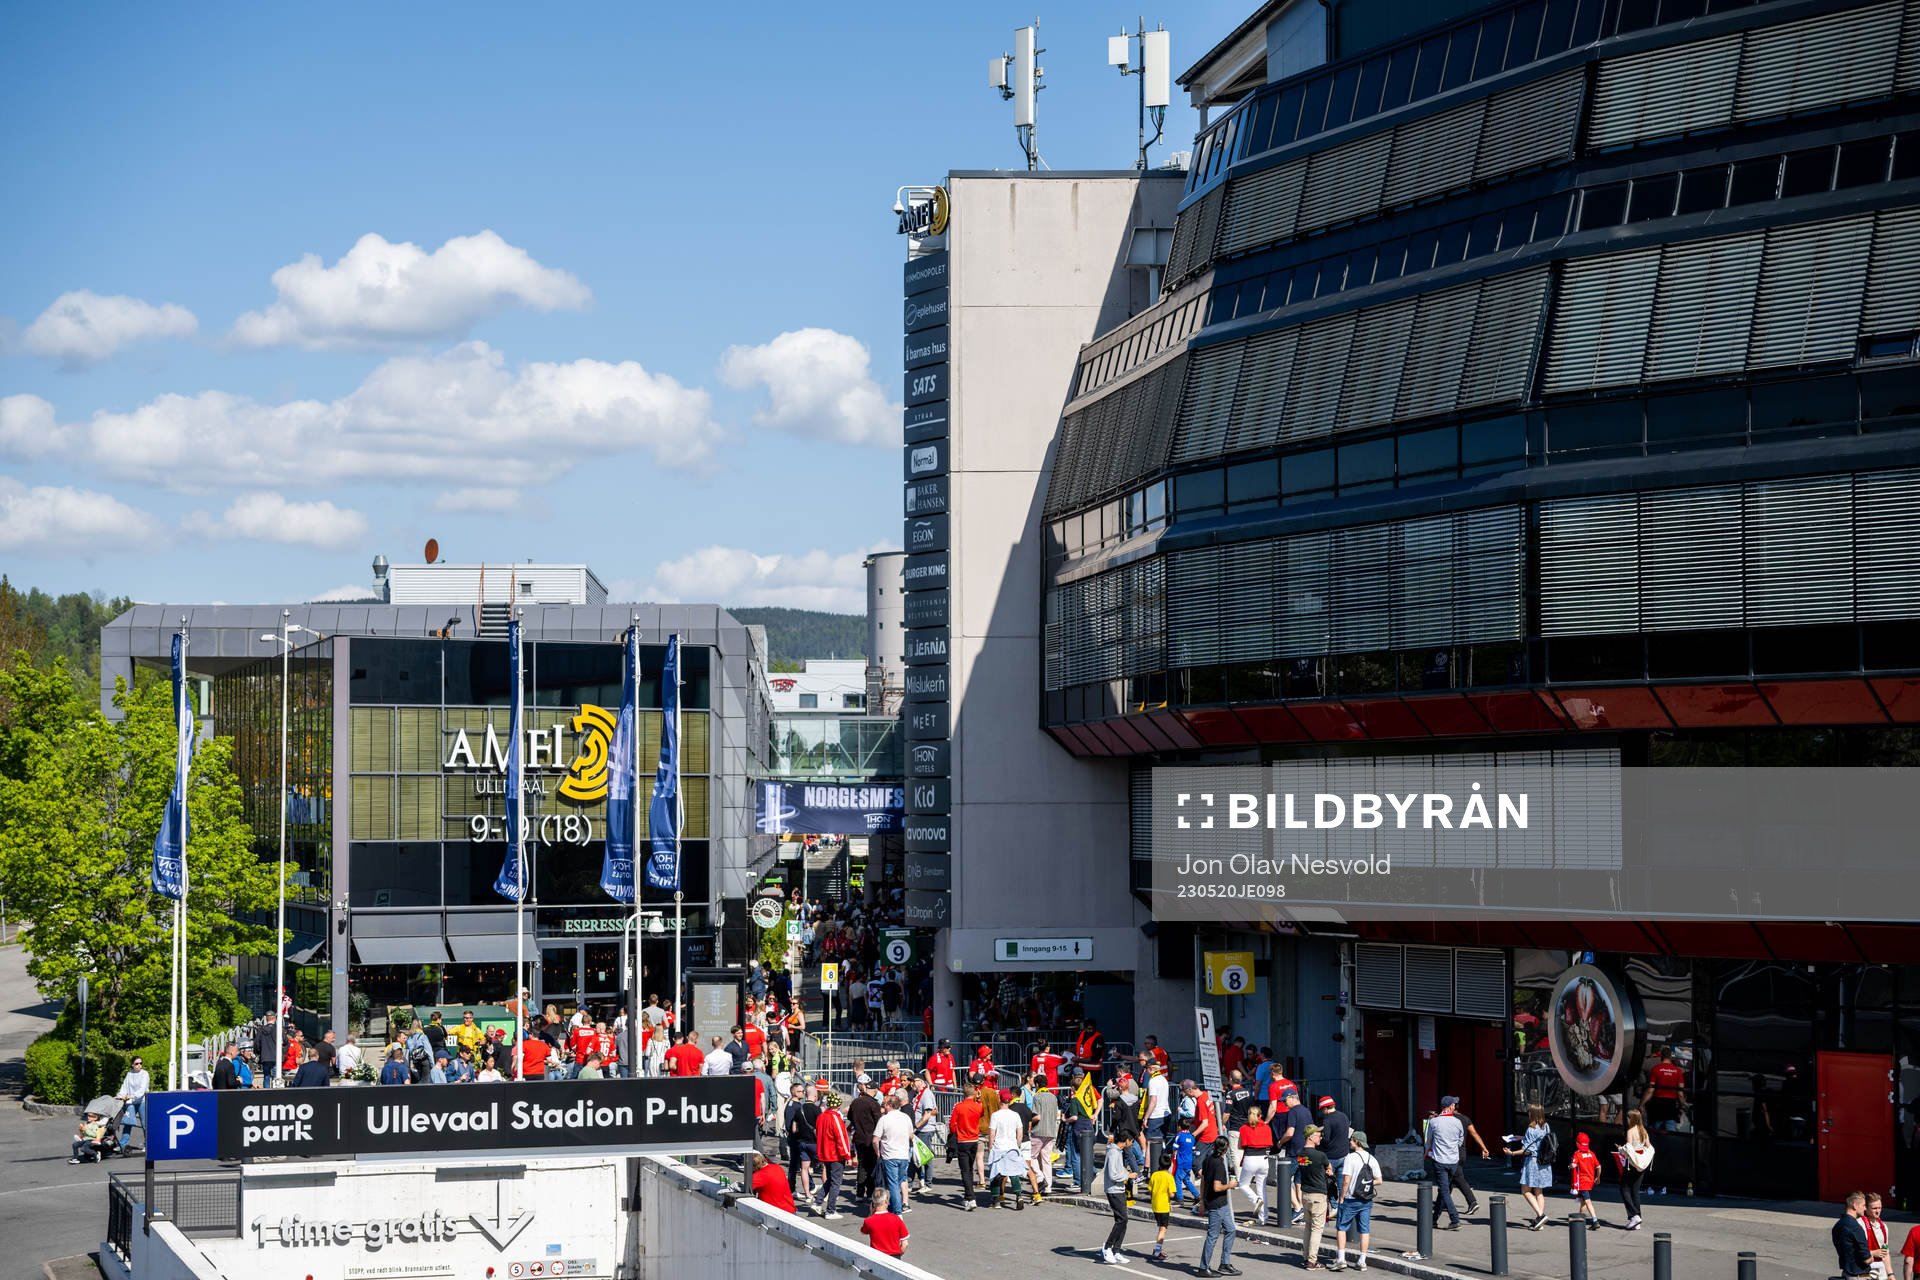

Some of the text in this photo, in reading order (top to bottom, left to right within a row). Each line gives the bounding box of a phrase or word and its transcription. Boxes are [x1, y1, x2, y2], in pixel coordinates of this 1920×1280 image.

[896, 198, 935, 234] AMFI
[909, 342, 946, 360] barnas hus
[912, 374, 937, 396] SATS
[913, 451, 935, 467] Normal
[917, 484, 938, 496] BAKER
[917, 496, 945, 509] HANSEN
[912, 529, 934, 543] EGON
[905, 563, 946, 580] BURGER KING
[912, 713, 937, 729] MEET
[444, 723, 566, 772] AMFI
[912, 745, 938, 762] THON
[914, 764, 935, 773] HOTELS
[475, 779, 550, 794] ULLAAL
[914, 784, 935, 808] Kid
[864, 812, 894, 823] THON
[540, 814, 593, 847] (18)
[906, 827, 946, 841] avonova
[564, 917, 687, 932] ESPRESSO HUSE
[893, 945, 905, 961] 9
[1022, 945, 1051, 953] Inngang
[828, 971, 834, 979] 8
[1229, 972, 1241, 990] 8
[1200, 1012, 1210, 1038] P
[242, 1103, 314, 1122] aimo
[367, 1096, 733, 1134] Ullevaal Stadion P-hus
[169, 1114, 195, 1149] P
[243, 1120, 314, 1147] park
[252, 1208, 459, 1250] 1 time gratis
[514, 1266, 520, 1274] 5
